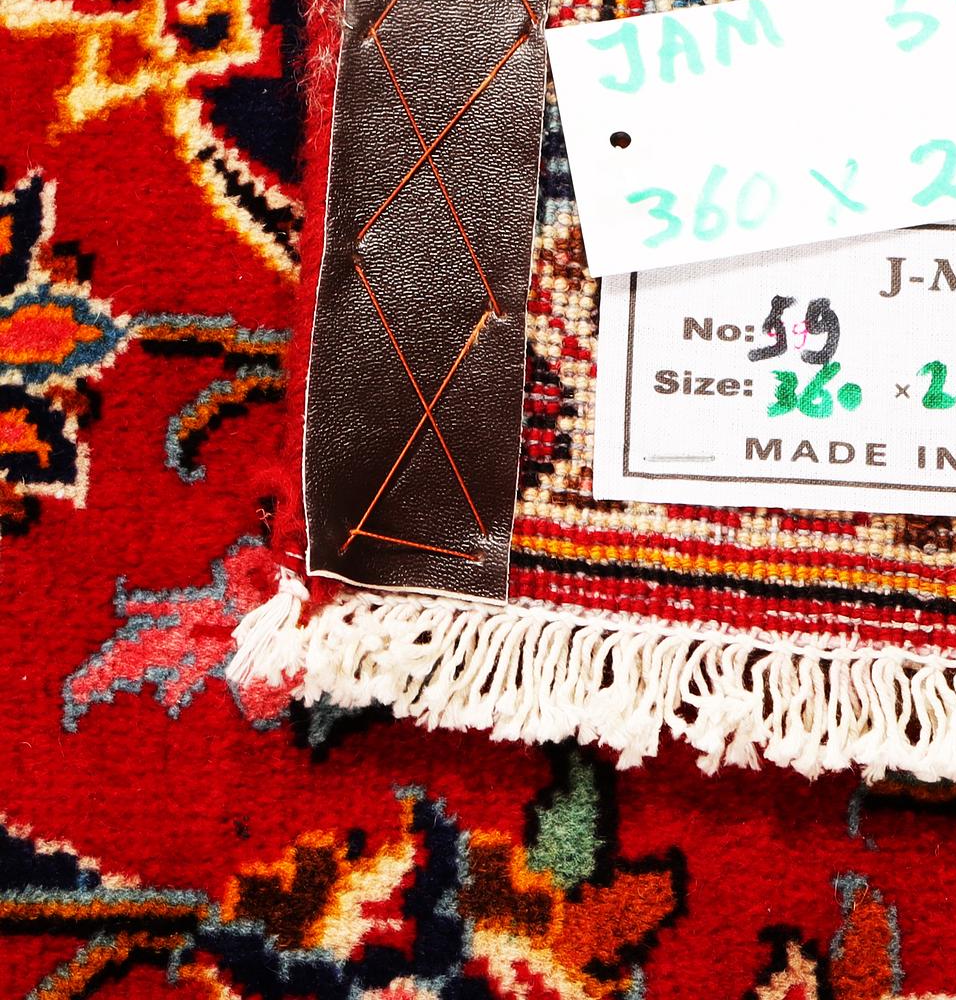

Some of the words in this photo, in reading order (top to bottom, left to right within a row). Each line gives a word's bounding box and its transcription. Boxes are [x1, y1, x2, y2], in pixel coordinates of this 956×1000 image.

[626, 165, 777, 248] 360
[683, 316, 755, 342] No:
[747, 294, 841, 365] 59
[653, 369, 754, 397] Size:
[767, 360, 863, 419] 360
[745, 437, 888, 467] MADE
